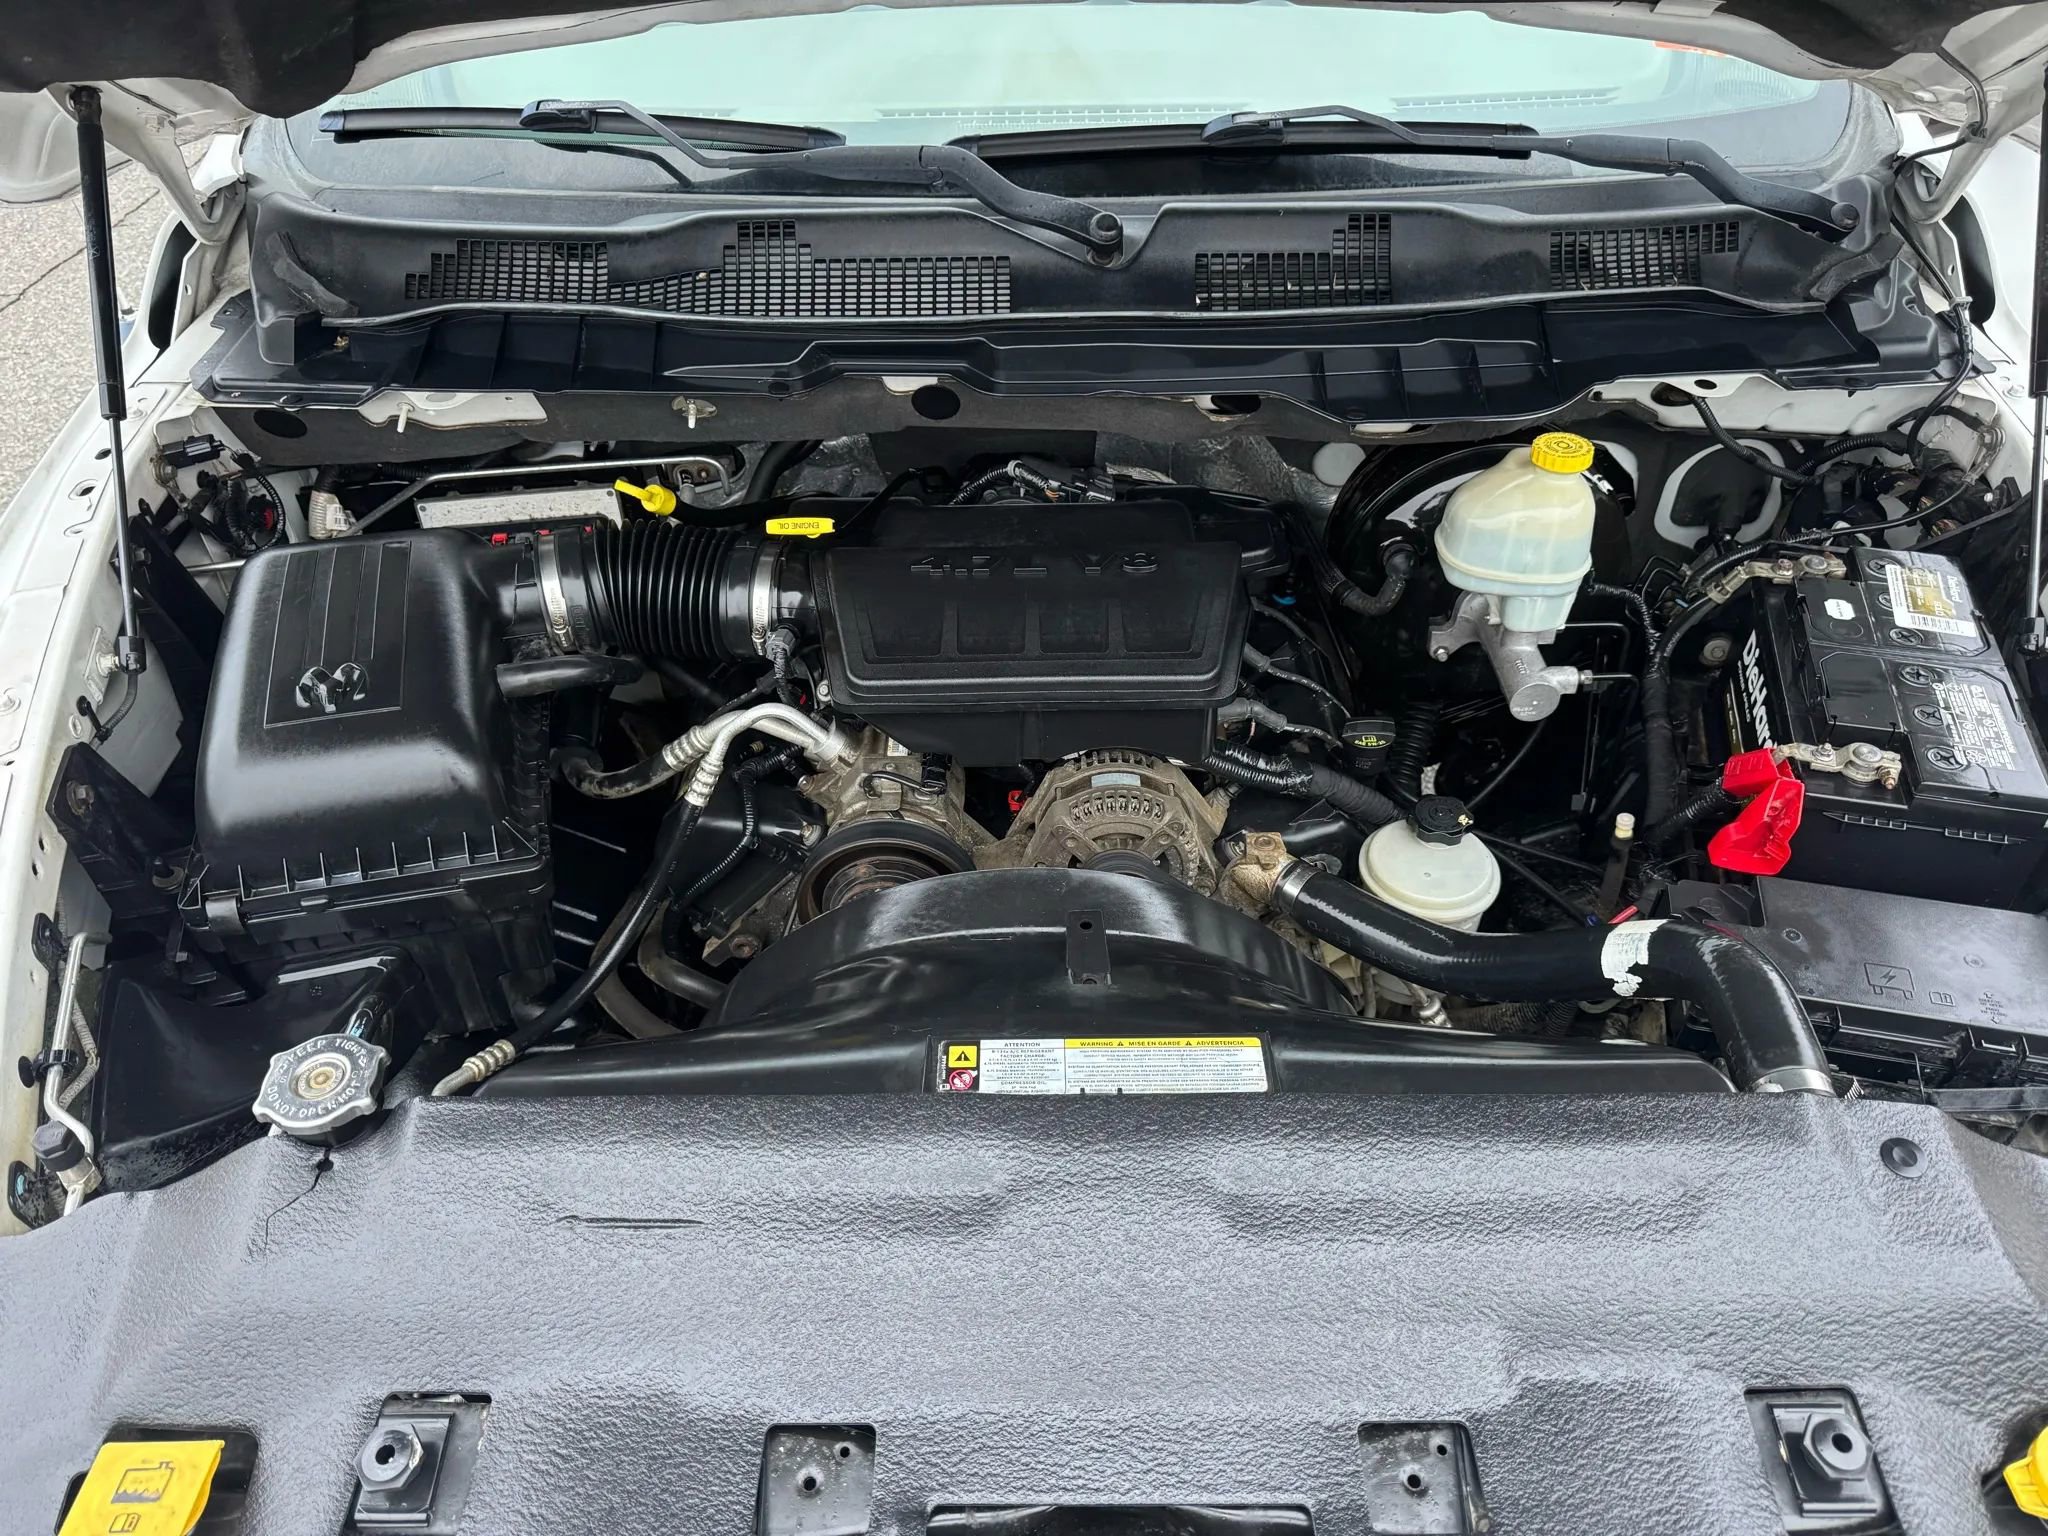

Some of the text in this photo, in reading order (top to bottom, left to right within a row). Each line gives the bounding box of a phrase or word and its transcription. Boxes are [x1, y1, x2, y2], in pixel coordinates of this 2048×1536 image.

[777, 521, 820, 530] ENGINE OIL
[287, 1038, 367, 1062] KEEP TIGHT
